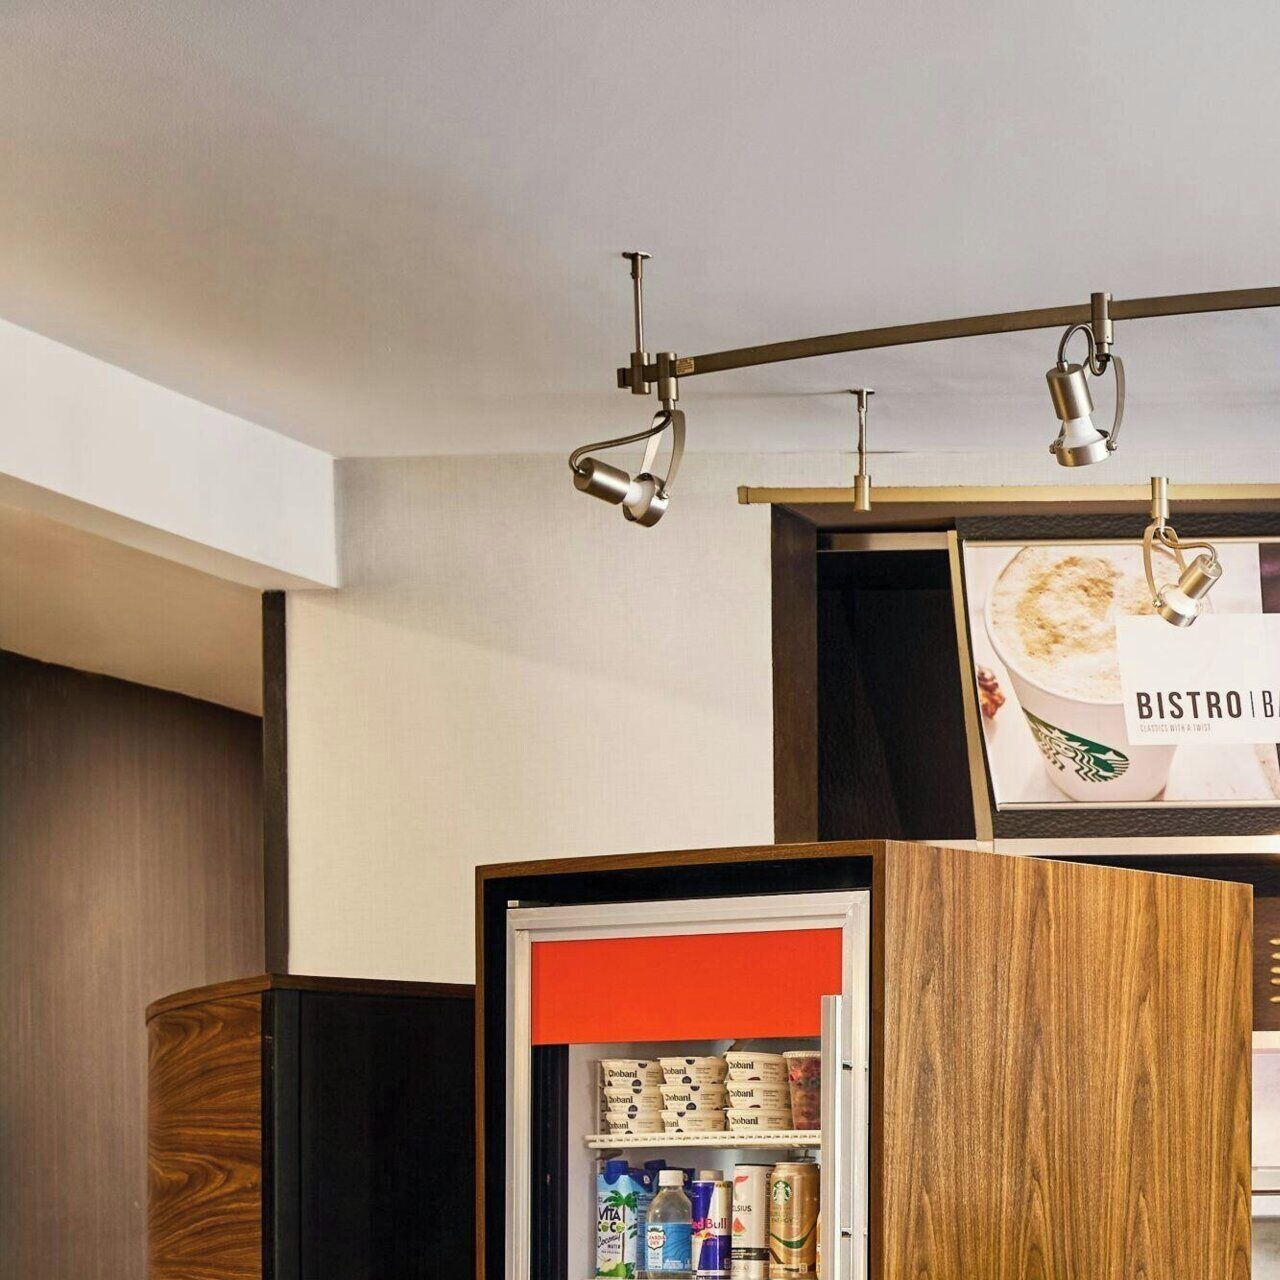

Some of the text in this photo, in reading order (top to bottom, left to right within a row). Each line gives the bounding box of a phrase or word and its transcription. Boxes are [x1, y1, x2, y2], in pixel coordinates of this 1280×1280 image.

[1136, 691, 1242, 719] BISTRO
[599, 1206, 621, 1220] VITA
[705, 1218, 727, 1229] Bull
